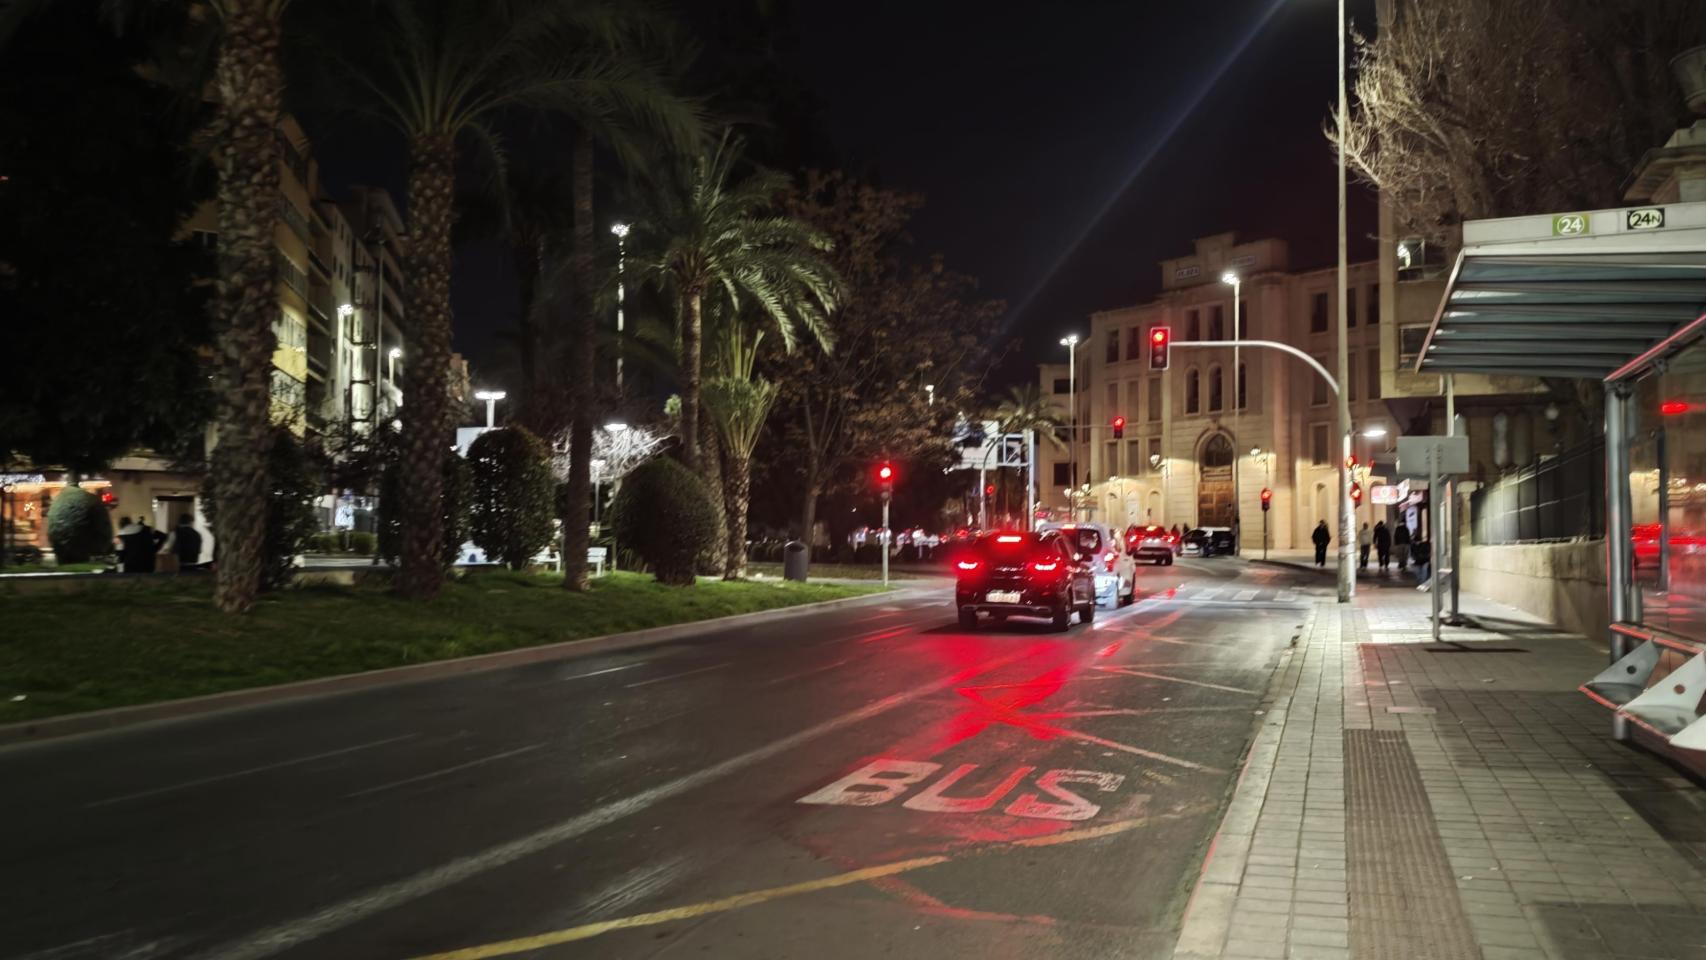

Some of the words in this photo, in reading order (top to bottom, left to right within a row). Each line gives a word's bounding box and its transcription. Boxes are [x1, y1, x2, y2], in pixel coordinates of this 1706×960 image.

[1561, 217, 1581, 233] 24
[1632, 212, 1660, 226] 24N
[796, 759, 1125, 821] BUS
